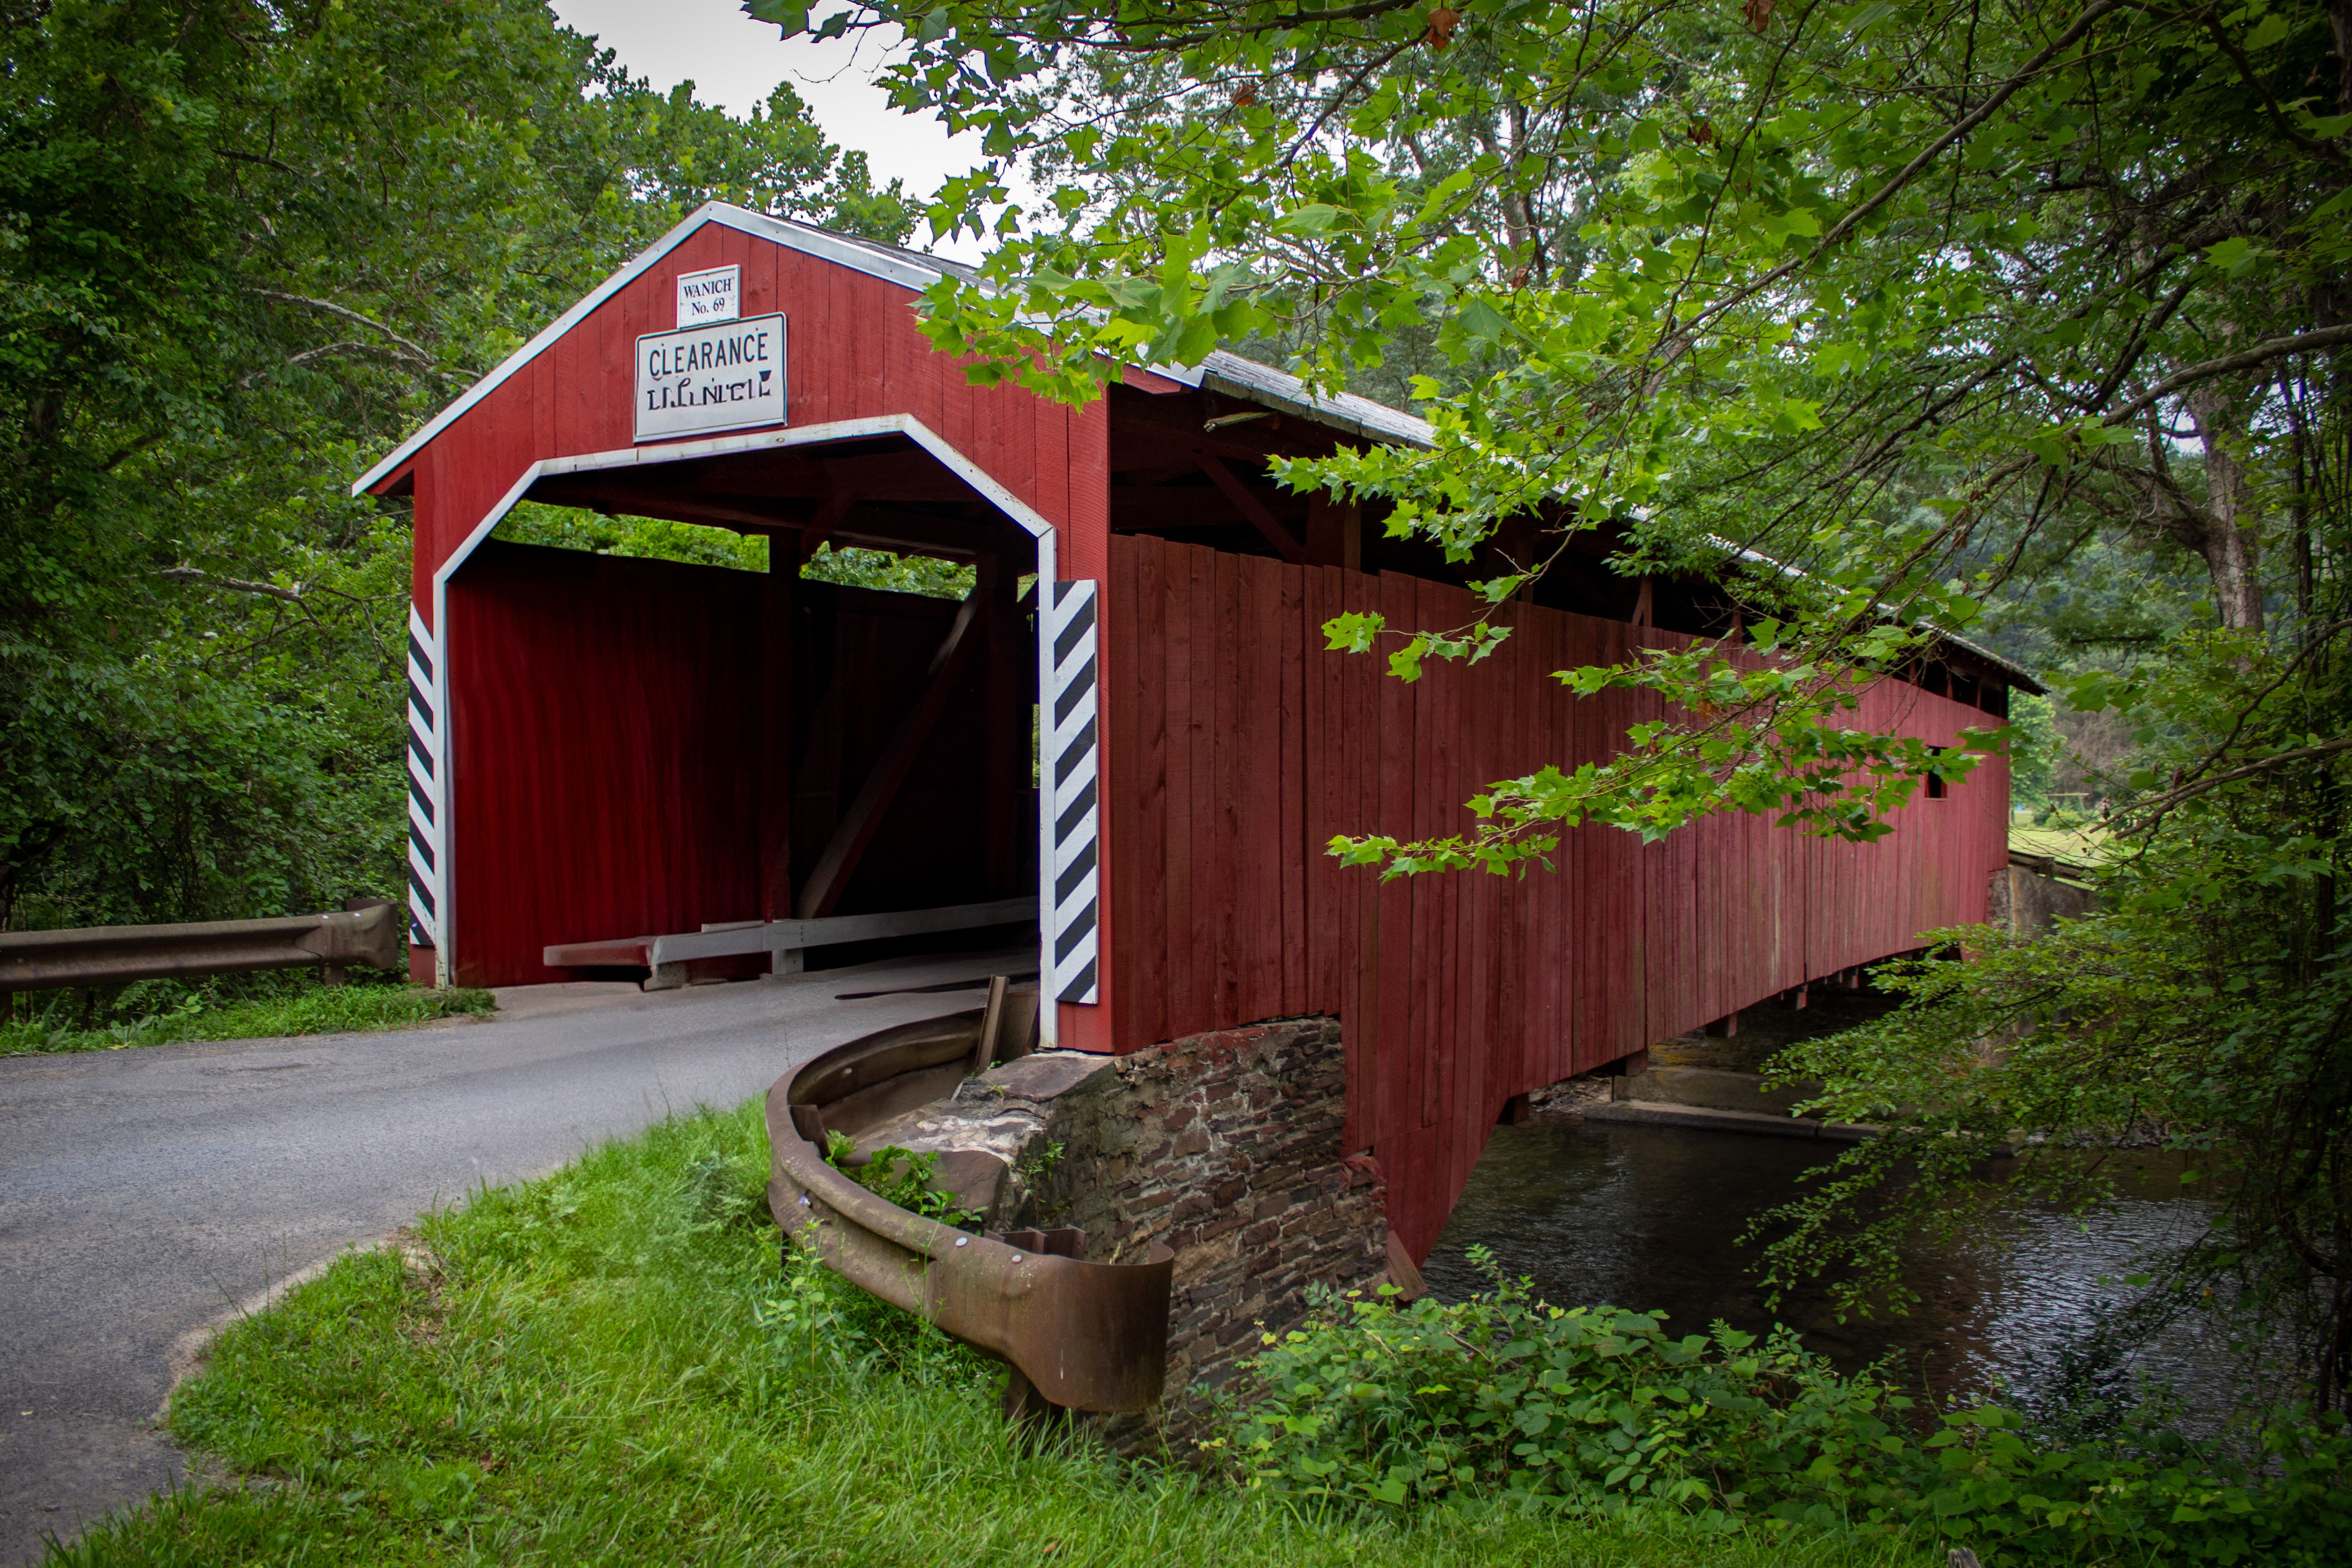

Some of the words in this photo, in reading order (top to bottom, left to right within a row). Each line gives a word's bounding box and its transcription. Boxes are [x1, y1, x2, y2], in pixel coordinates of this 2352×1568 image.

[684, 278, 731, 299] WANICH
[692, 301, 709, 315] No.
[713, 297, 725, 312] 69
[649, 332, 769, 377] CLEARANCE
